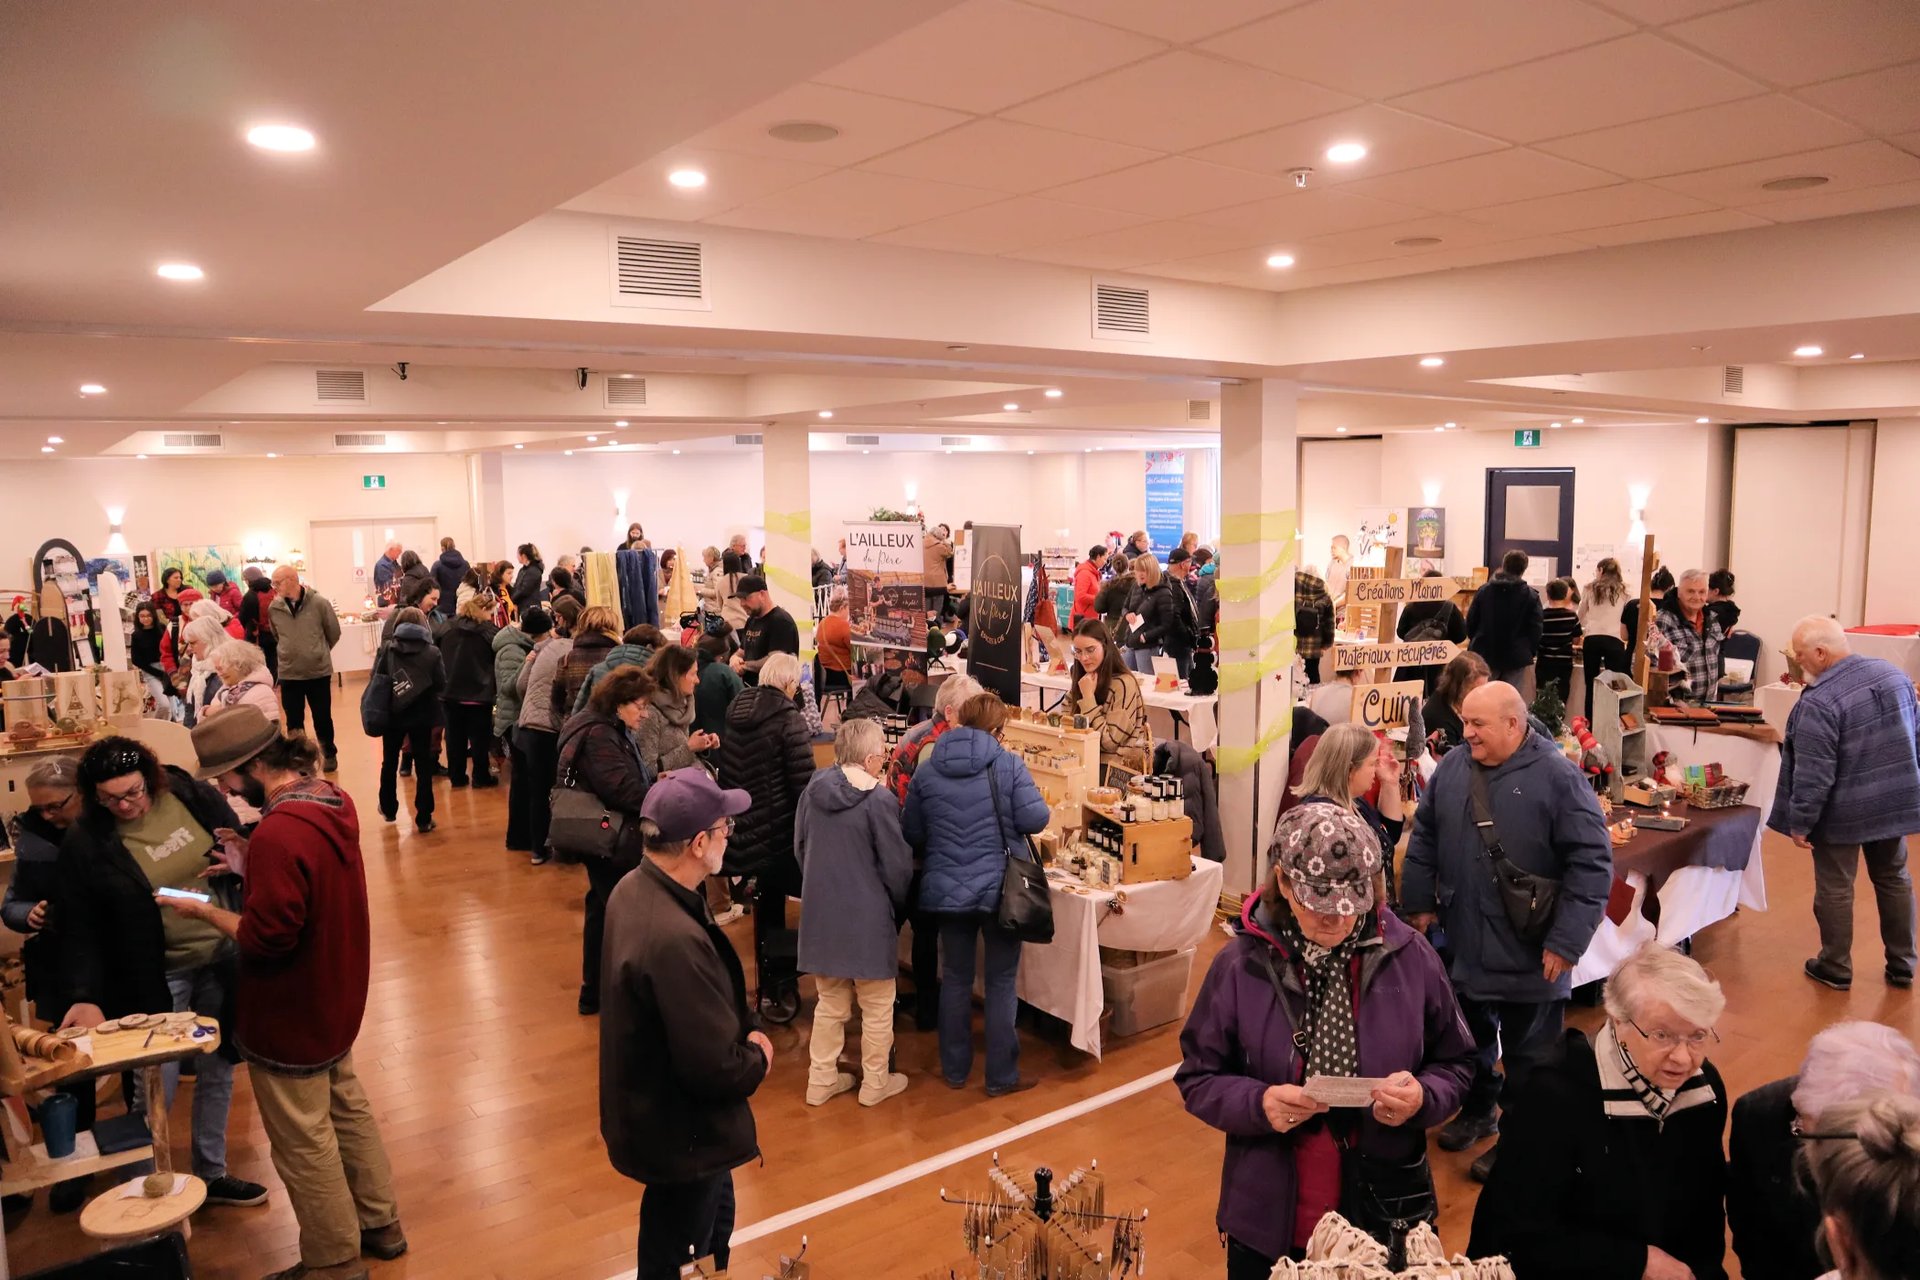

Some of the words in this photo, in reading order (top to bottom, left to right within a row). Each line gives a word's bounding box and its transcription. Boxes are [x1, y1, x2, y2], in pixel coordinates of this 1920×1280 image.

[849, 532, 914, 548] L'AILLEUX
[972, 579, 1018, 602] L'AILLEUX
[1356, 580, 1404, 601] Créations
[1409, 578, 1443, 600] Manon
[1337, 646, 1391, 666] Matériaux
[1396, 642, 1447, 665] récupérés
